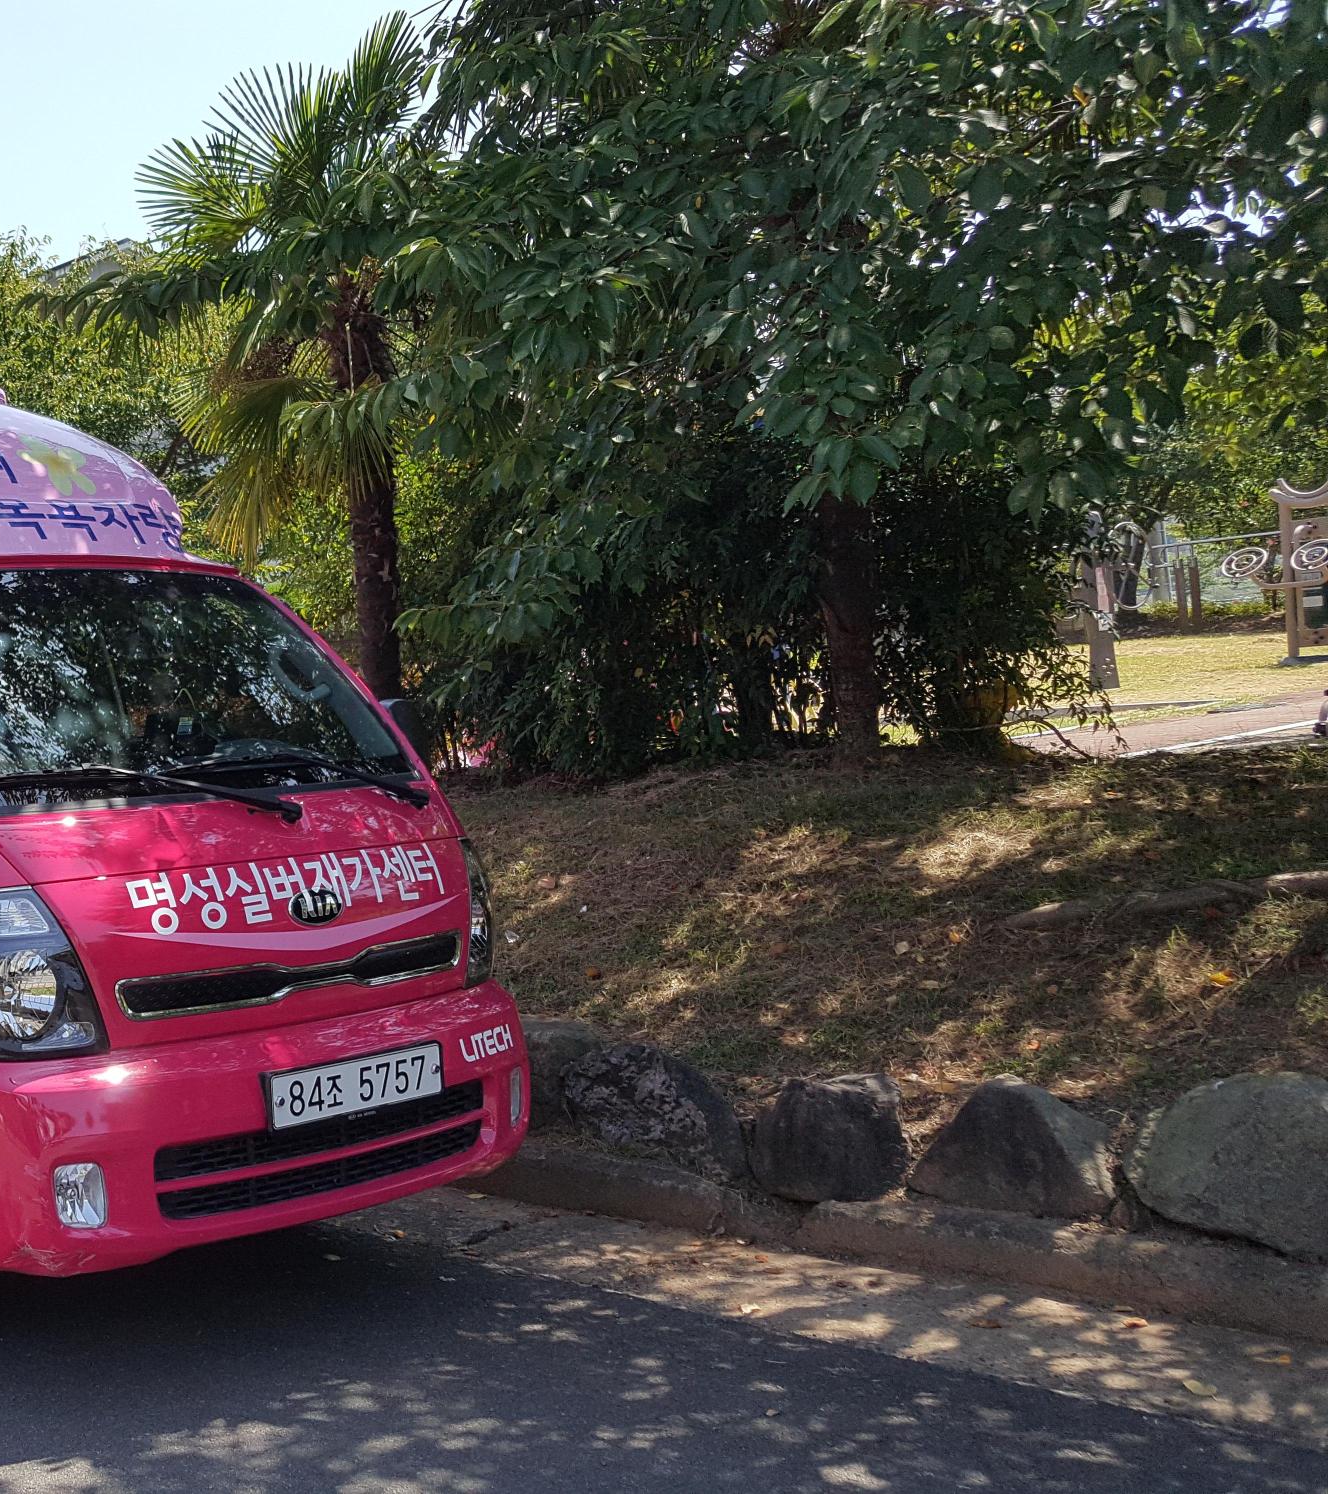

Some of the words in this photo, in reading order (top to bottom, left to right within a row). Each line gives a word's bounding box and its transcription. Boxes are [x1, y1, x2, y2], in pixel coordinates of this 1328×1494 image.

[125, 843, 444, 935] 명성실버재가센터
[298, 894, 340, 918] KIA
[459, 1023, 514, 1062] LITECH
[289, 1074, 343, 1117] 84조
[359, 1055, 425, 1102] 5757
